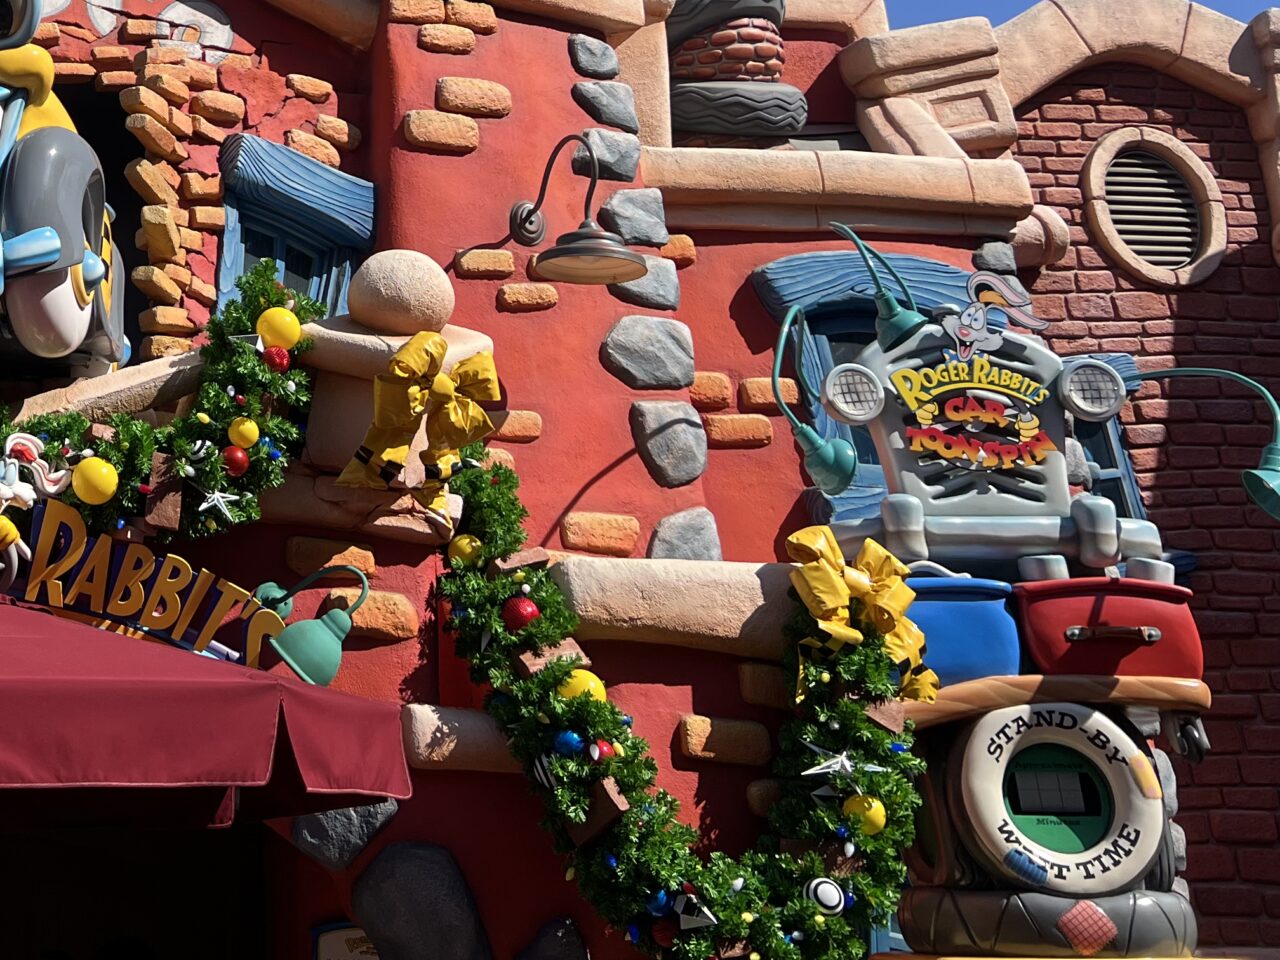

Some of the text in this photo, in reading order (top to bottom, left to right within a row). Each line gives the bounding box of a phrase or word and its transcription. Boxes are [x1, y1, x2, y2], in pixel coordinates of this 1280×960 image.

[890, 361, 969, 412] ROGER
[944, 395, 1009, 428] CAR
[986, 710, 1131, 768] STAND-BY
[997, 818, 1142, 881] WT TIME
